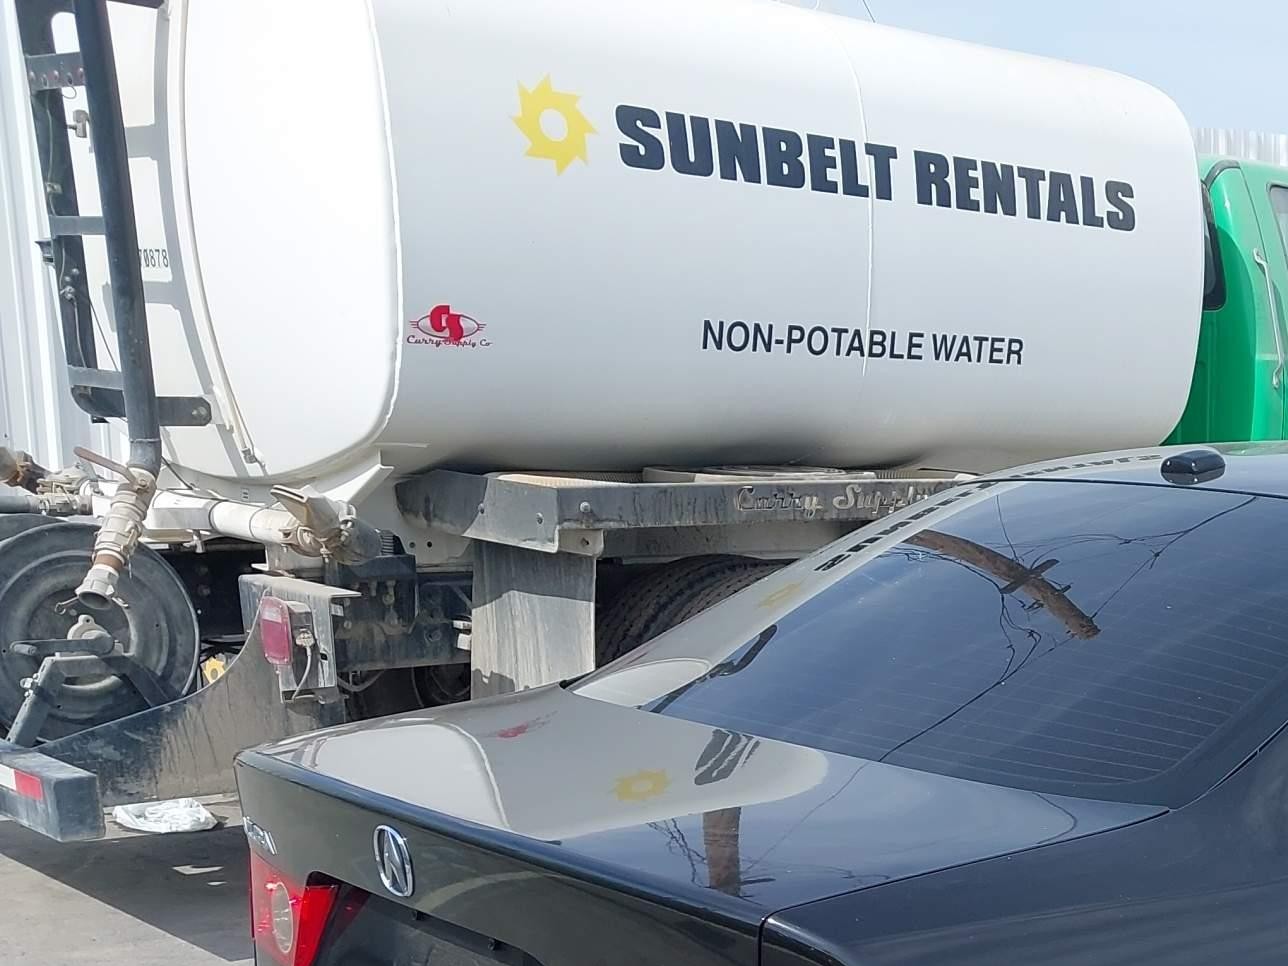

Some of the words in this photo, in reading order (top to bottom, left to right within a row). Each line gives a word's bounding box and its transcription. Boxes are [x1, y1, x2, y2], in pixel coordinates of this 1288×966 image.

[615, 104, 898, 201] SUNBELT
[913, 149, 1137, 233] RENTALS
[406, 335, 443, 348] Curry
[701, 319, 925, 362] NON-POTABLE
[932, 333, 1024, 366] WATER
[735, 485, 823, 518] Curry
